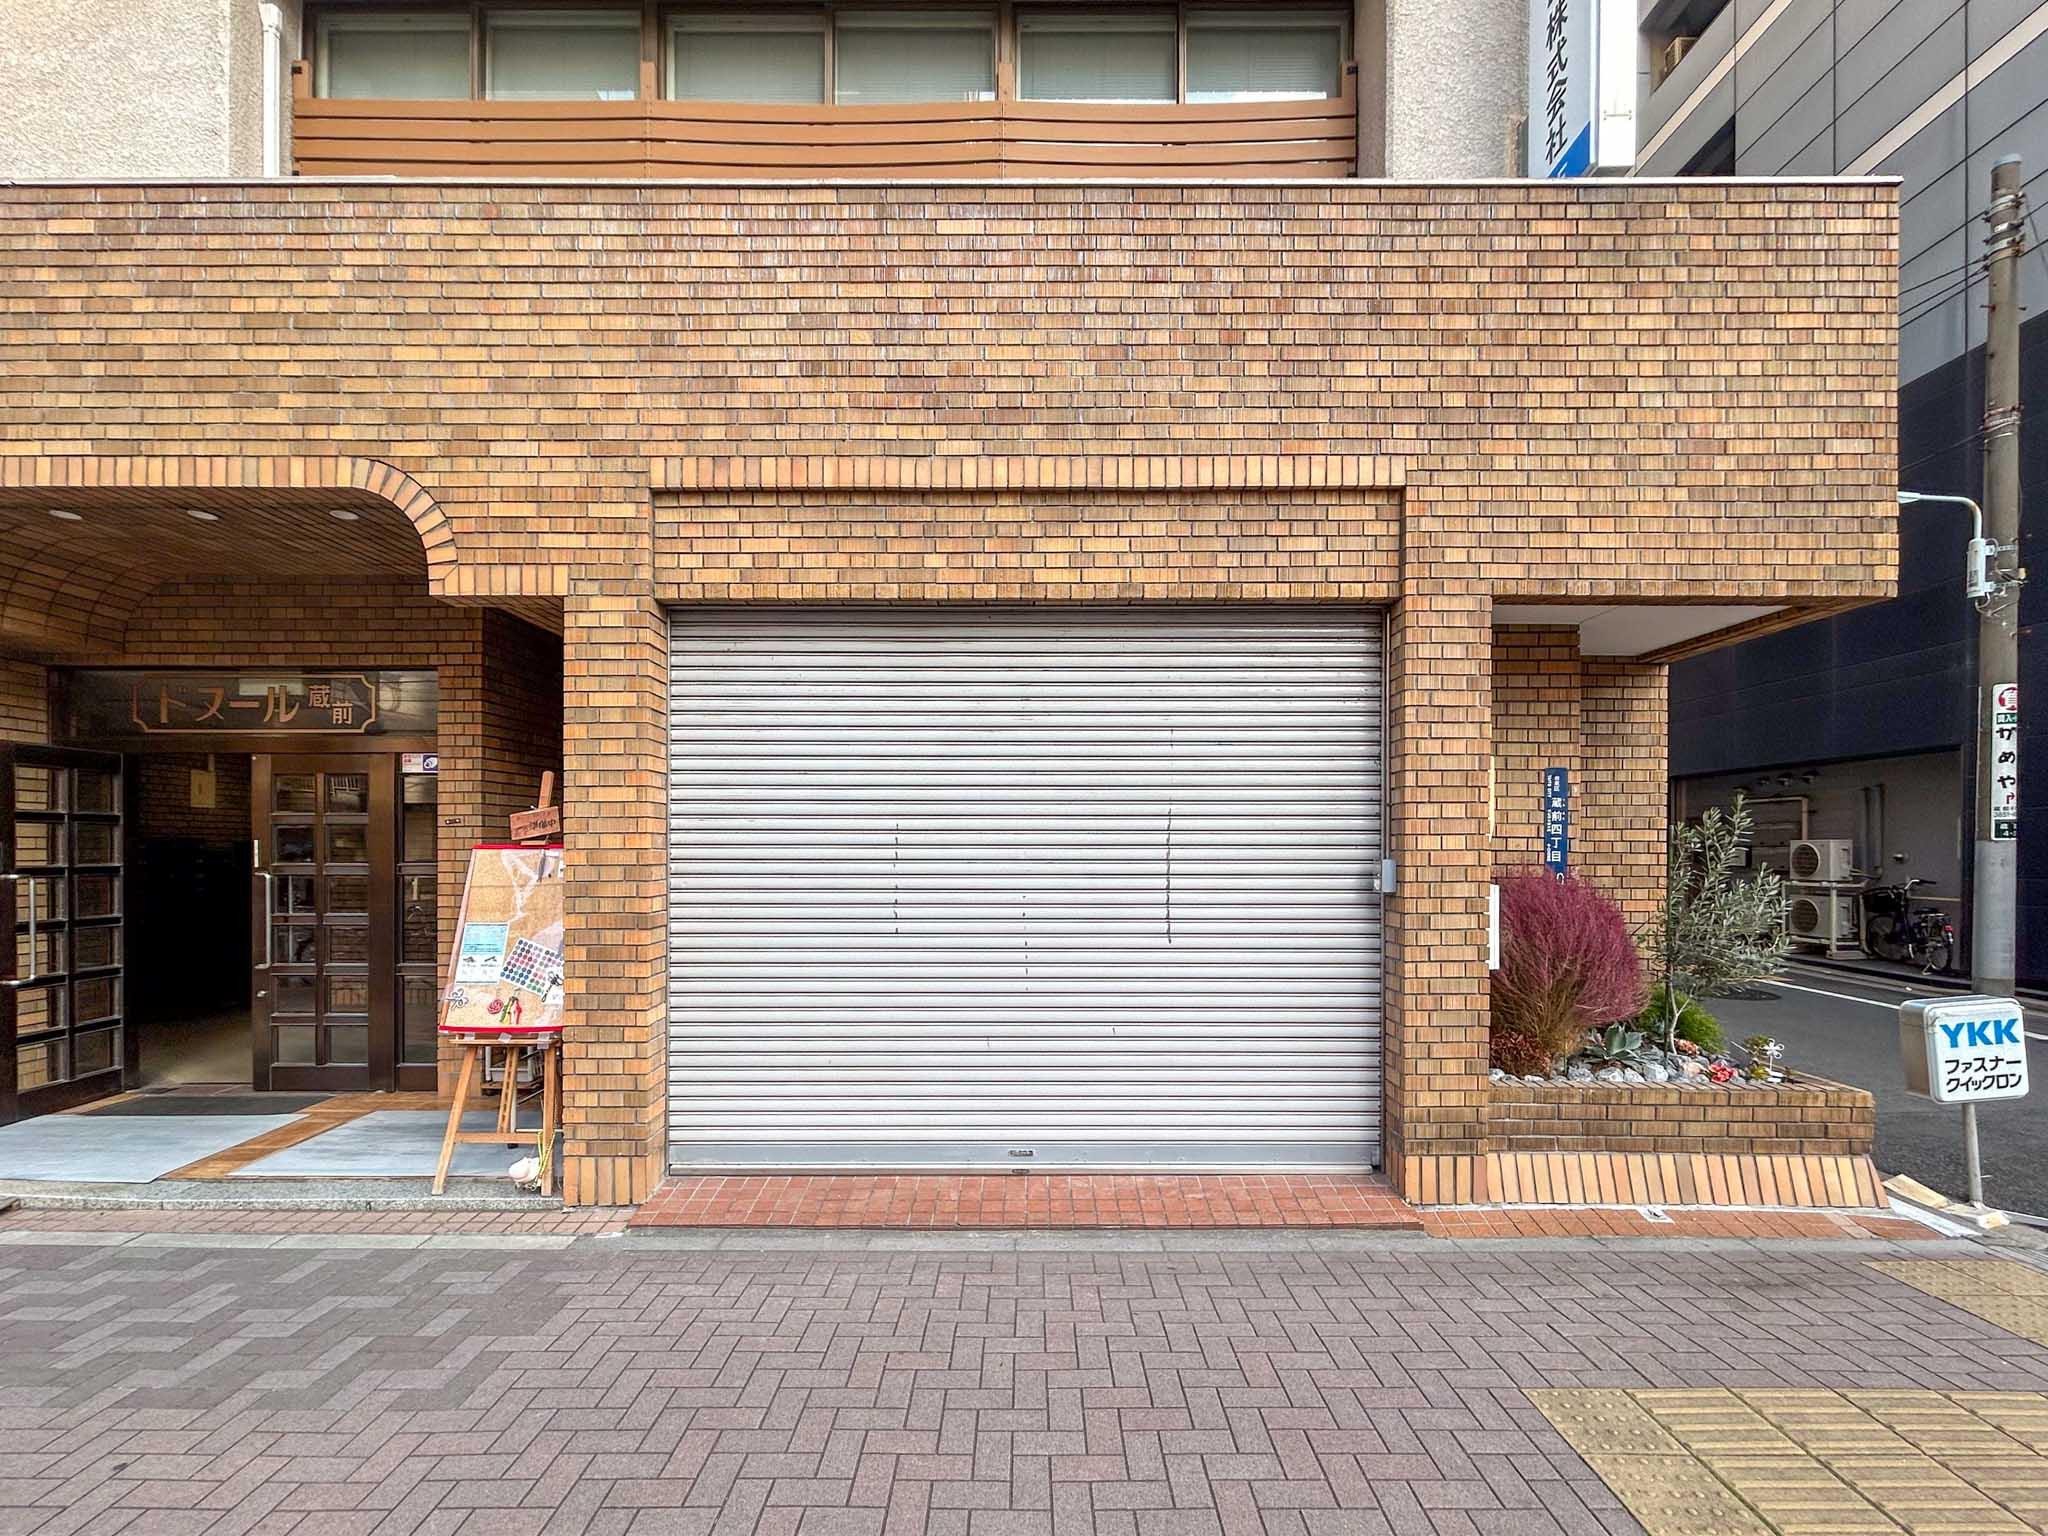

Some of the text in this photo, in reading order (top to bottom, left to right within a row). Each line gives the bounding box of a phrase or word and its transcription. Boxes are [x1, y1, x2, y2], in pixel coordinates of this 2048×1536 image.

[159, 684, 353, 725] ドヌール 蔵前
[1551, 797, 1563, 862] 蔵前四丁目
[1938, 1018, 2021, 1049] YKK
[1944, 1055, 2022, 1075] ファスナー
[1945, 1073, 2023, 1093] クイックロン
